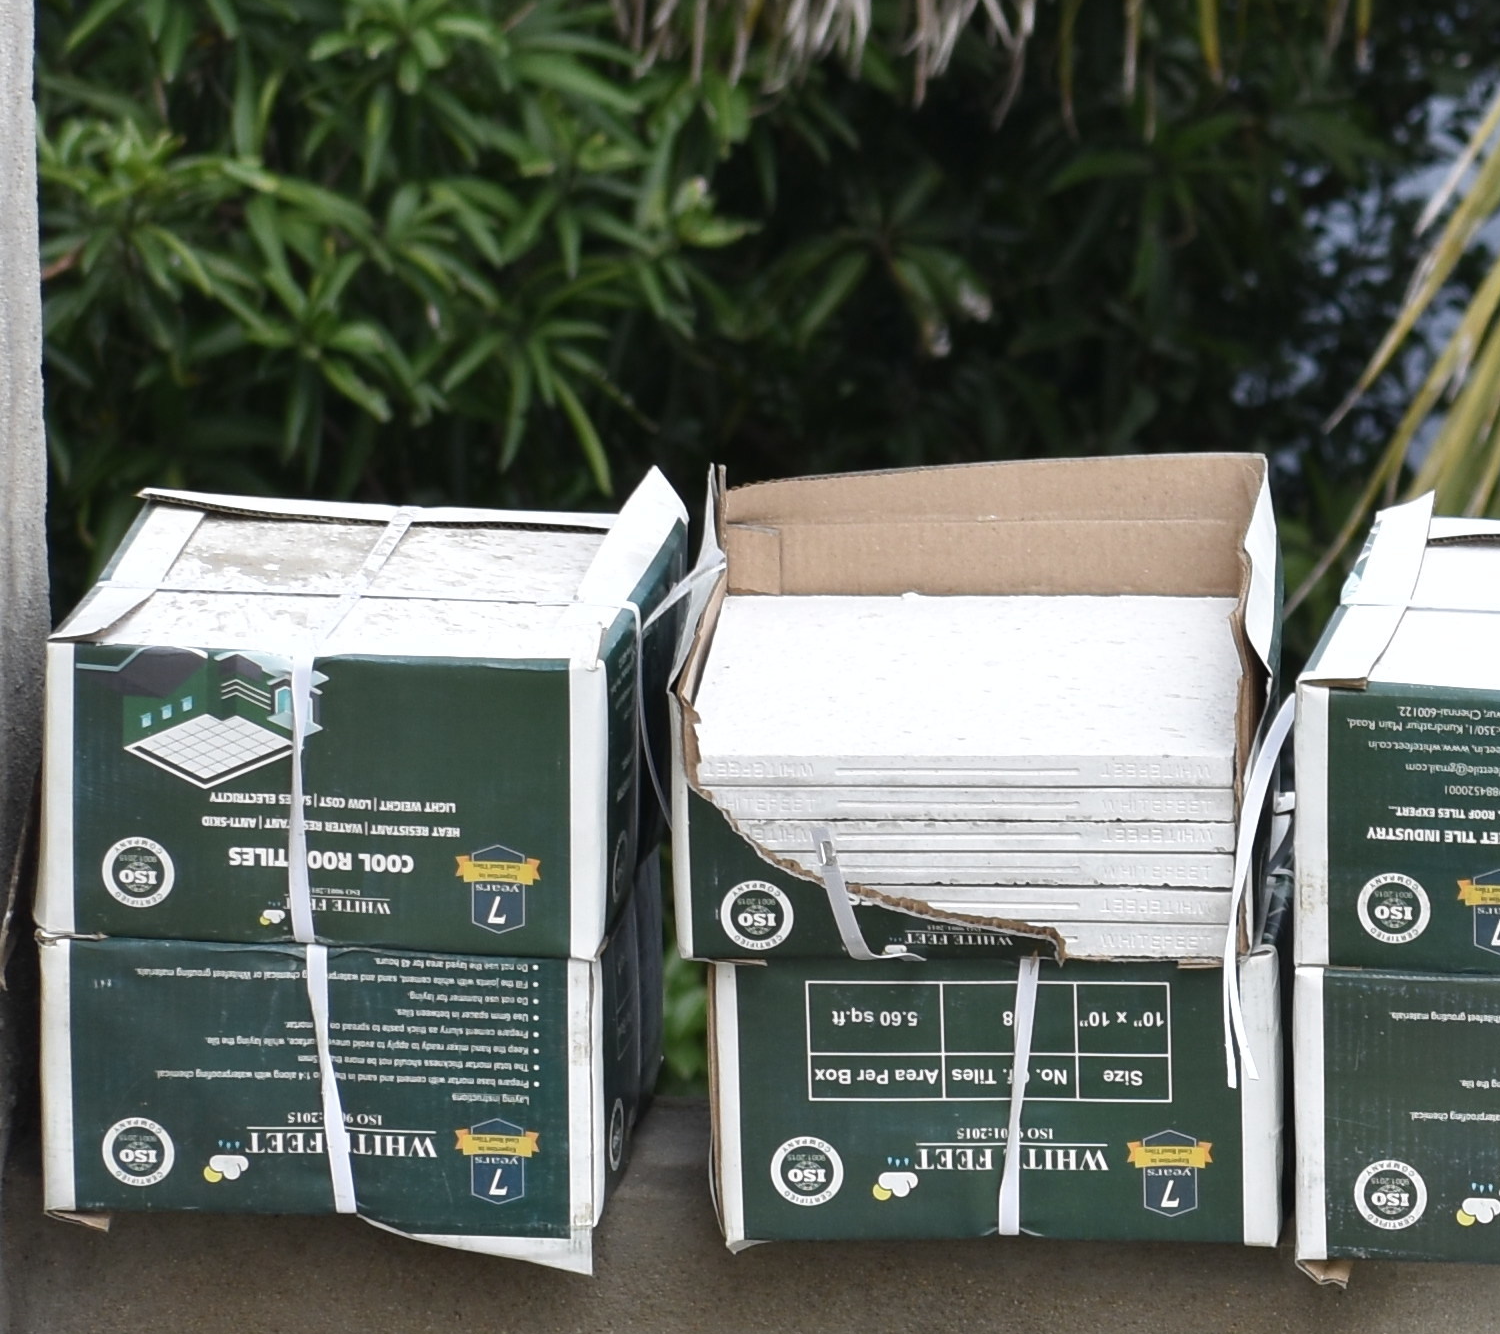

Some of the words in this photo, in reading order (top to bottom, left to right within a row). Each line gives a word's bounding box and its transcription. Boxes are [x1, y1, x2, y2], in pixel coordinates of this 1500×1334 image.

[1347, 718, 1376, 730] Road,
[1378, 721, 1403, 731] Main
[1405, 722, 1463, 734] Kundrathur
[1368, 741, 1470, 754] www.whitefeet.co.in
[209, 792, 276, 804] ELECTRICITY
[319, 797, 346, 808] COST
[348, 798, 372, 810] LOW
[379, 800, 422, 812] WEIGHT
[424, 802, 456, 813] LIGHT
[1388, 806, 1435, 818] EXPERT...
[1437, 808, 1466, 819] TILES
[1468, 809, 1495, 820] ROOF
[201, 816, 257, 828] ANTI-SKID
[325, 821, 362, 834] WATER
[370, 825, 429, 836] RESISTANT
[431, 827, 460, 837] HEAT
[1366, 827, 1440, 842] INDUSTRY
[1444, 830, 1477, 844] TILE
[228, 847, 289, 867] TILES
[307, 850, 352, 871] ROO
[358, 853, 414, 873] COOL
[119, 868, 157, 884] ISO
[332, 899, 390, 915] WHITE
[488, 896, 507, 924] 7
[1374, 904, 1413, 920] ISO
[905, 933, 948, 944] FEET
[954, 935, 1013, 945] WHITE
[832, 1007, 873, 1026] sq.ft
[880, 1010, 918, 1026] 5.60
[814, 1067, 851, 1084] Box
[857, 1068, 889, 1084] Per
[894, 1068, 938, 1085] Area
[952, 1067, 994, 1085] Tiles
[1036, 1068, 1068, 1085] No.
[1103, 1069, 1143, 1086] Size
[1028, 1127, 1054, 1139] ISO
[245, 1131, 321, 1154] FEET
[915, 1147, 993, 1170] FEET
[788, 1168, 826, 1183] ISO
[1147, 1168, 1191, 1177] years
[489, 1168, 508, 1195] 7
[1161, 1180, 1179, 1207] 7
[1371, 1192, 1409, 1206] ISO
